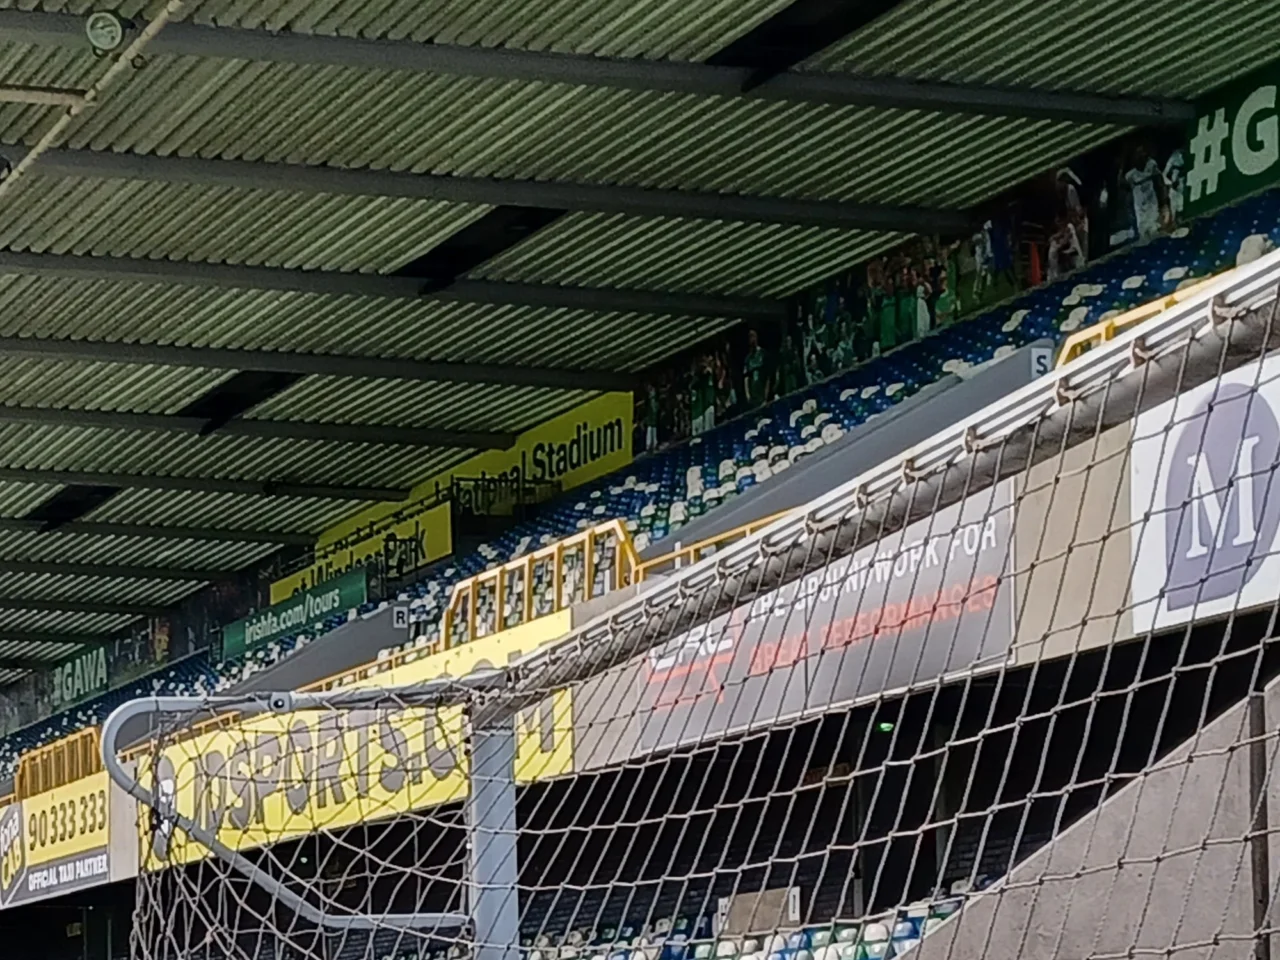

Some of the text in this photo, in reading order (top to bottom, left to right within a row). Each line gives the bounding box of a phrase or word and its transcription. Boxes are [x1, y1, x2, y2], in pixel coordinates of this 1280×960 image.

[1036, 355, 1048, 375] S
[532, 418, 623, 482] Stadium
[1186, 435, 1261, 559] M
[948, 516, 997, 560] FOR
[244, 588, 340, 645] irishfa.com/tours
[396, 602, 407, 624] R
